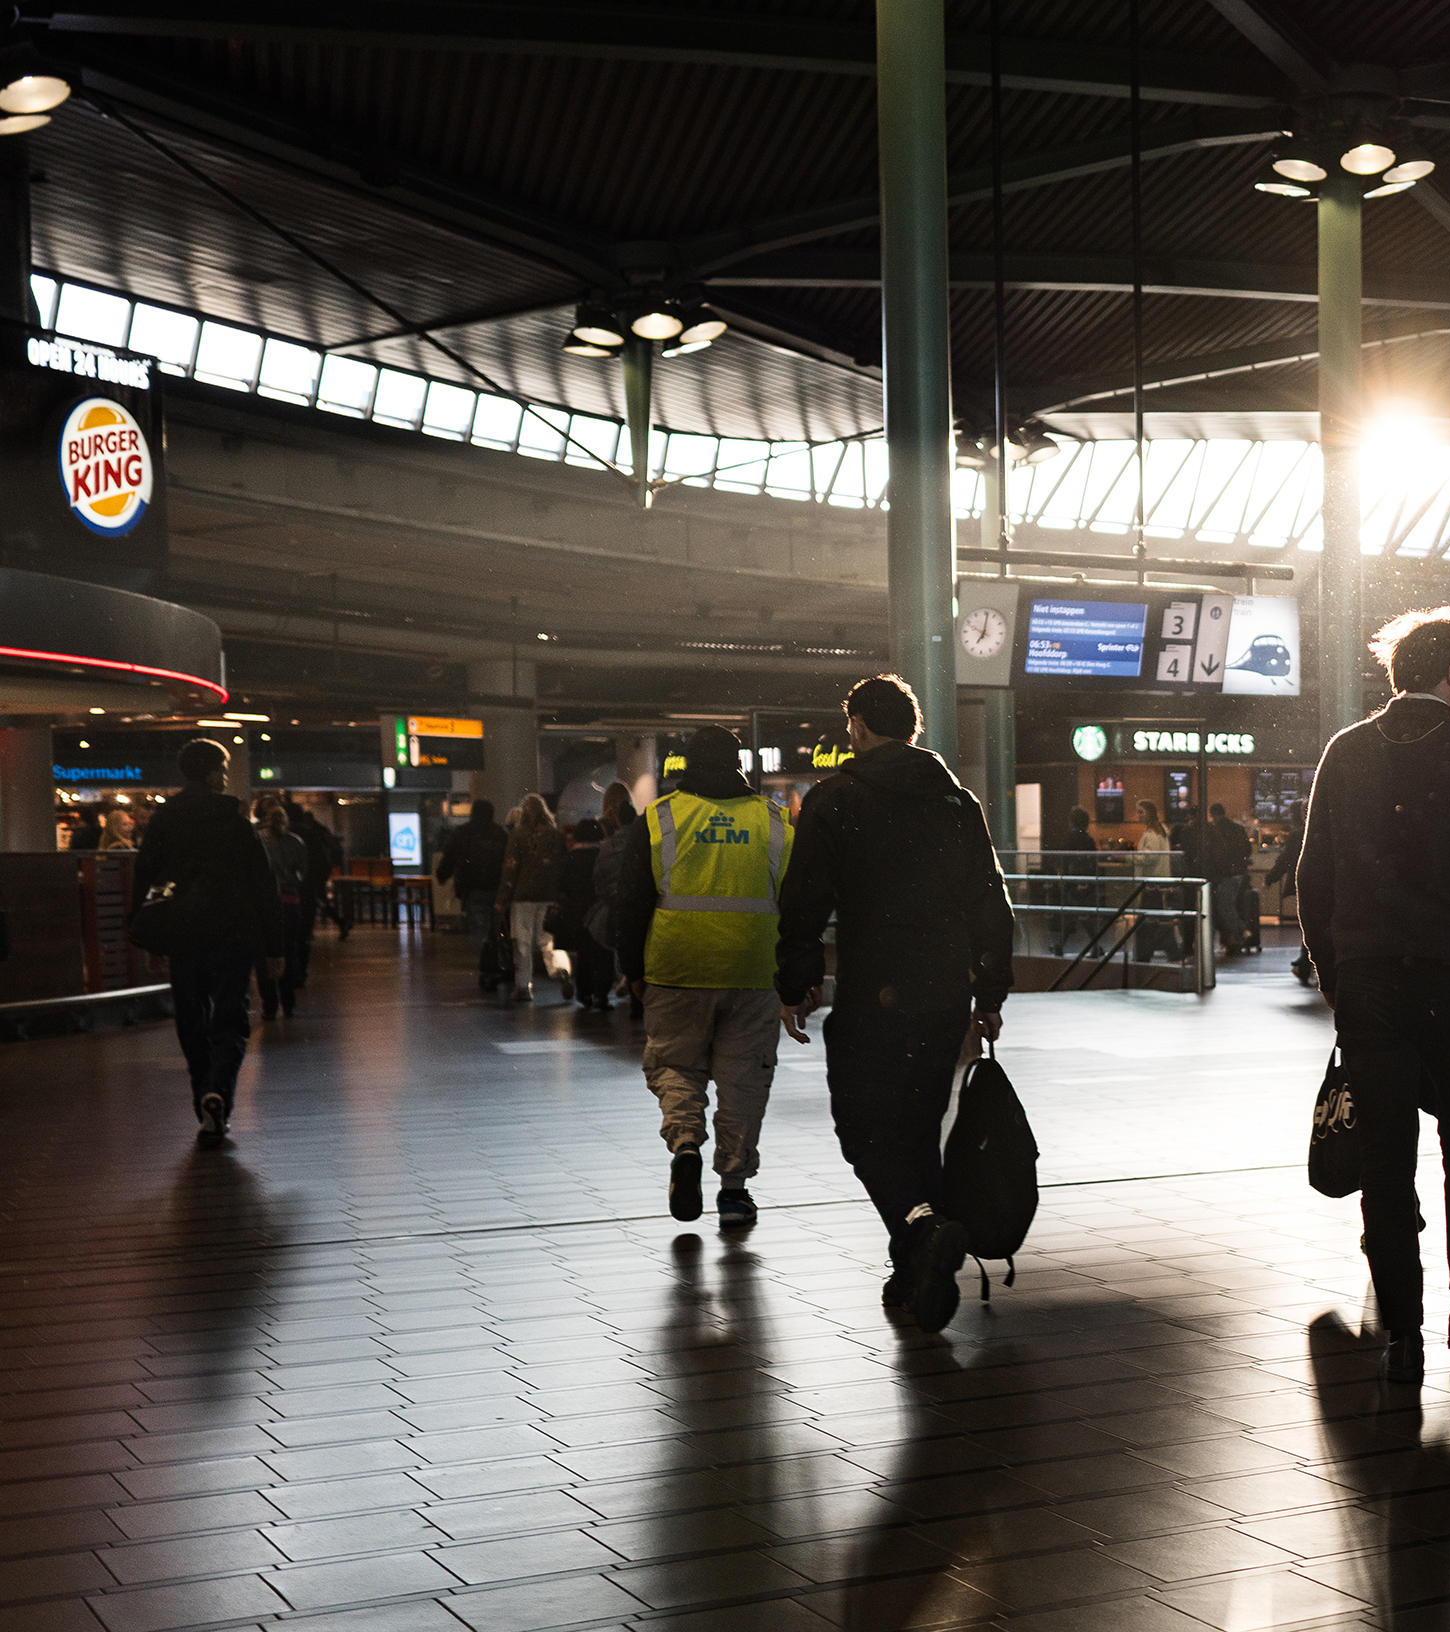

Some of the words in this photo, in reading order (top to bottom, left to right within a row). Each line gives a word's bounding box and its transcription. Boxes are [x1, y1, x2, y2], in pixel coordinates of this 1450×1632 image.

[27, 337, 73, 373] OPEN
[73, 349, 97, 378] 24
[97, 354, 150, 390] HOURS
[68, 429, 140, 466] BURGER
[73, 454, 142, 503] KING
[1172, 615, 1184, 635] 3
[1097, 642, 1125, 652] Sprinter
[1167, 658, 1179, 677] 4
[811, 744, 838, 769] food
[52, 764, 143, 782] Supermarkt
[694, 829, 750, 845] KLM
